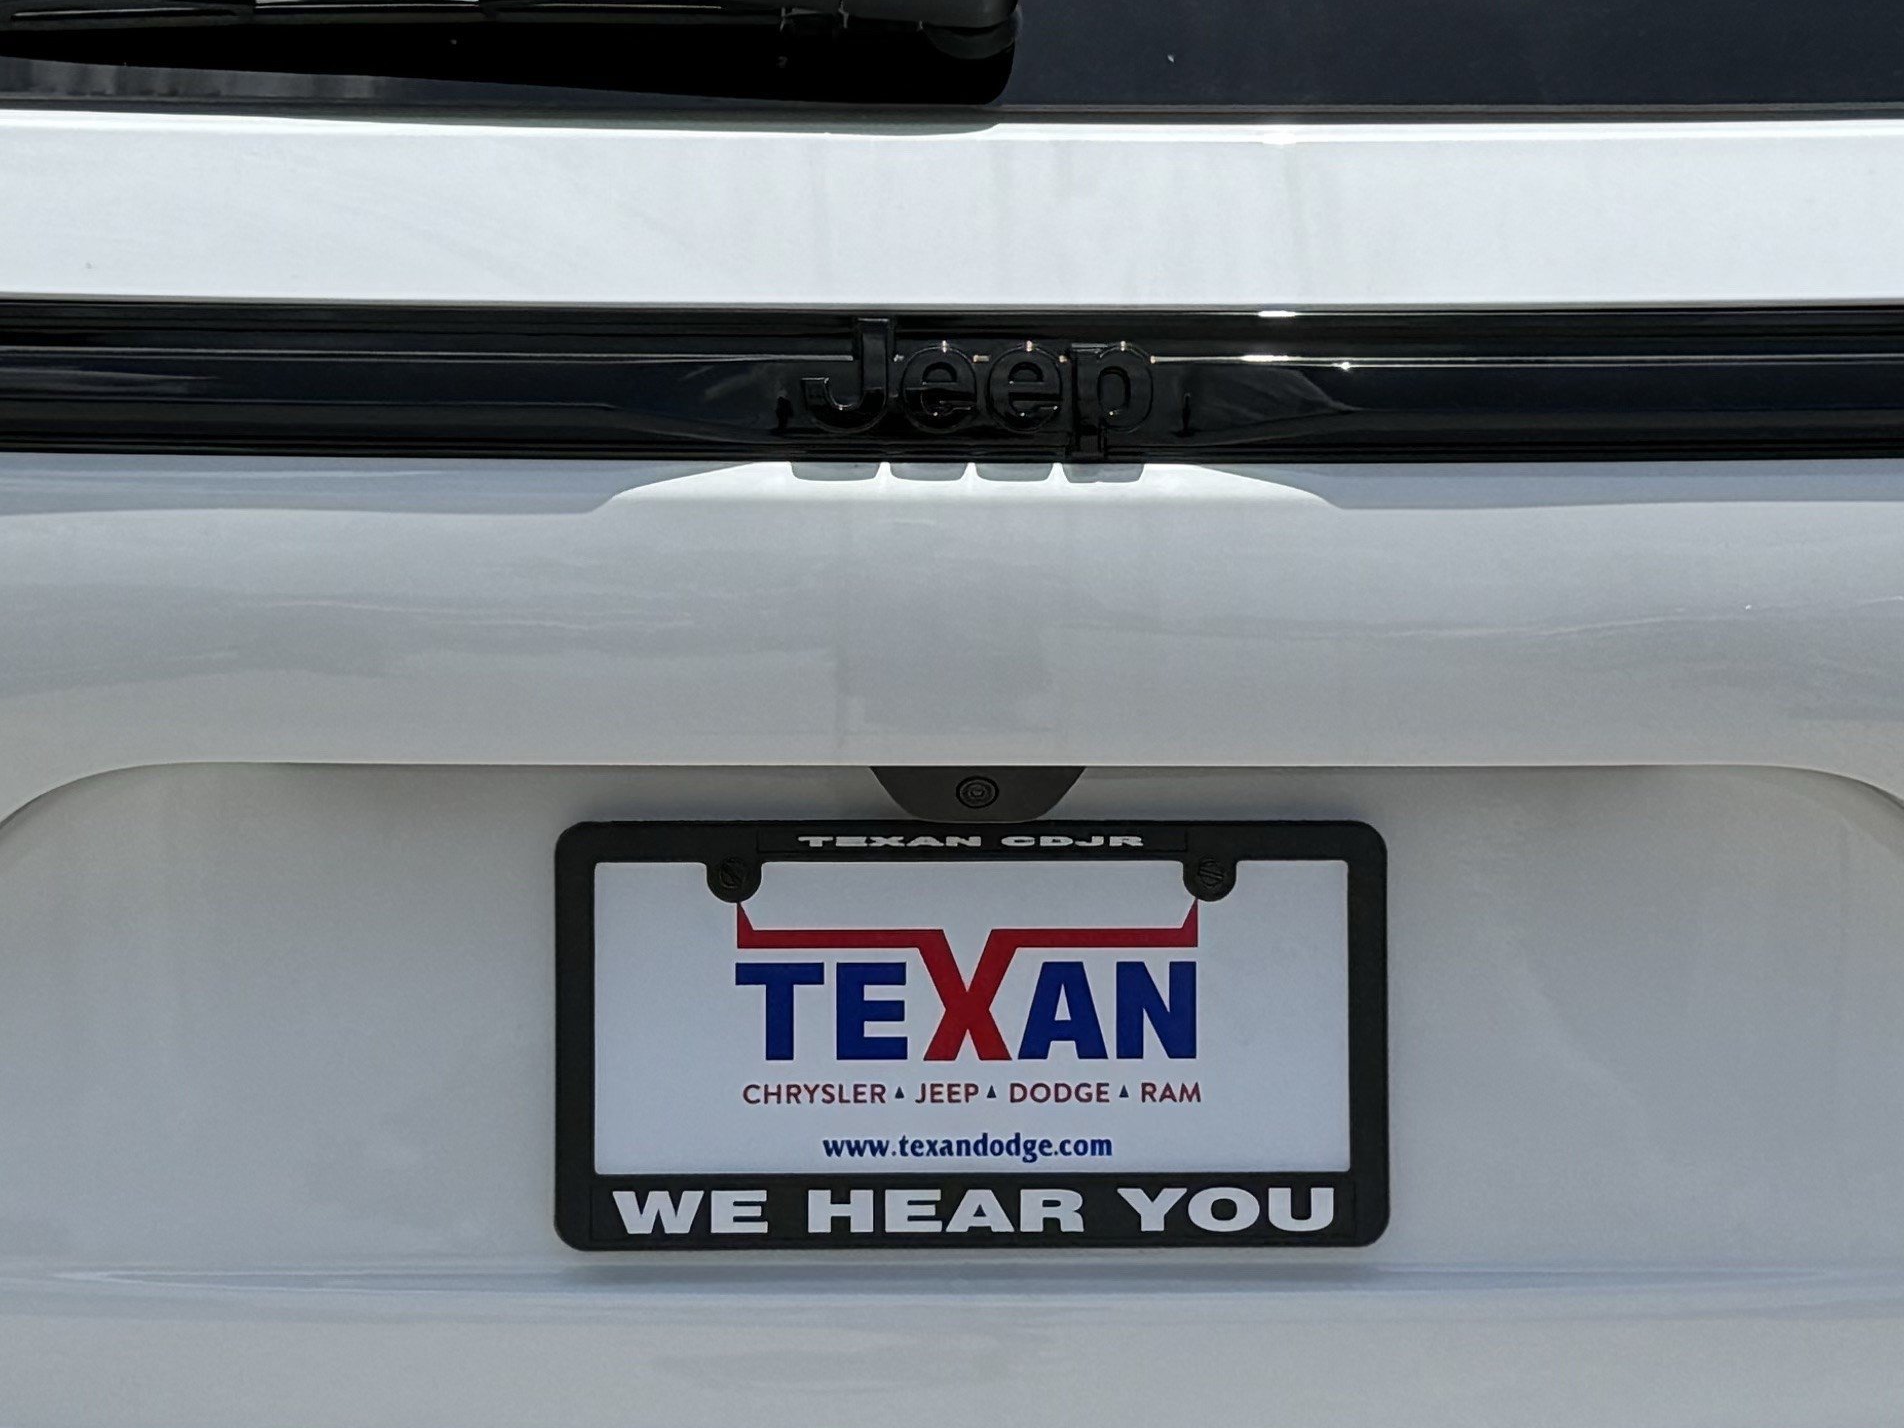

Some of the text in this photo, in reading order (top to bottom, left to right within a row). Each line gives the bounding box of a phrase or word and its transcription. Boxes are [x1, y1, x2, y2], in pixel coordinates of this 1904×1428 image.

[800, 318, 1154, 460] Jeep
[797, 835, 1146, 849] TEXAN CDJR
[734, 929, 1198, 1062] TEXAN
[741, 1081, 1202, 1106] CHRYSLER JEEP DODGE RAM
[821, 1133, 1113, 1164] www.texandodge.com
[612, 1186, 1336, 1236] WE HEAR YOU
